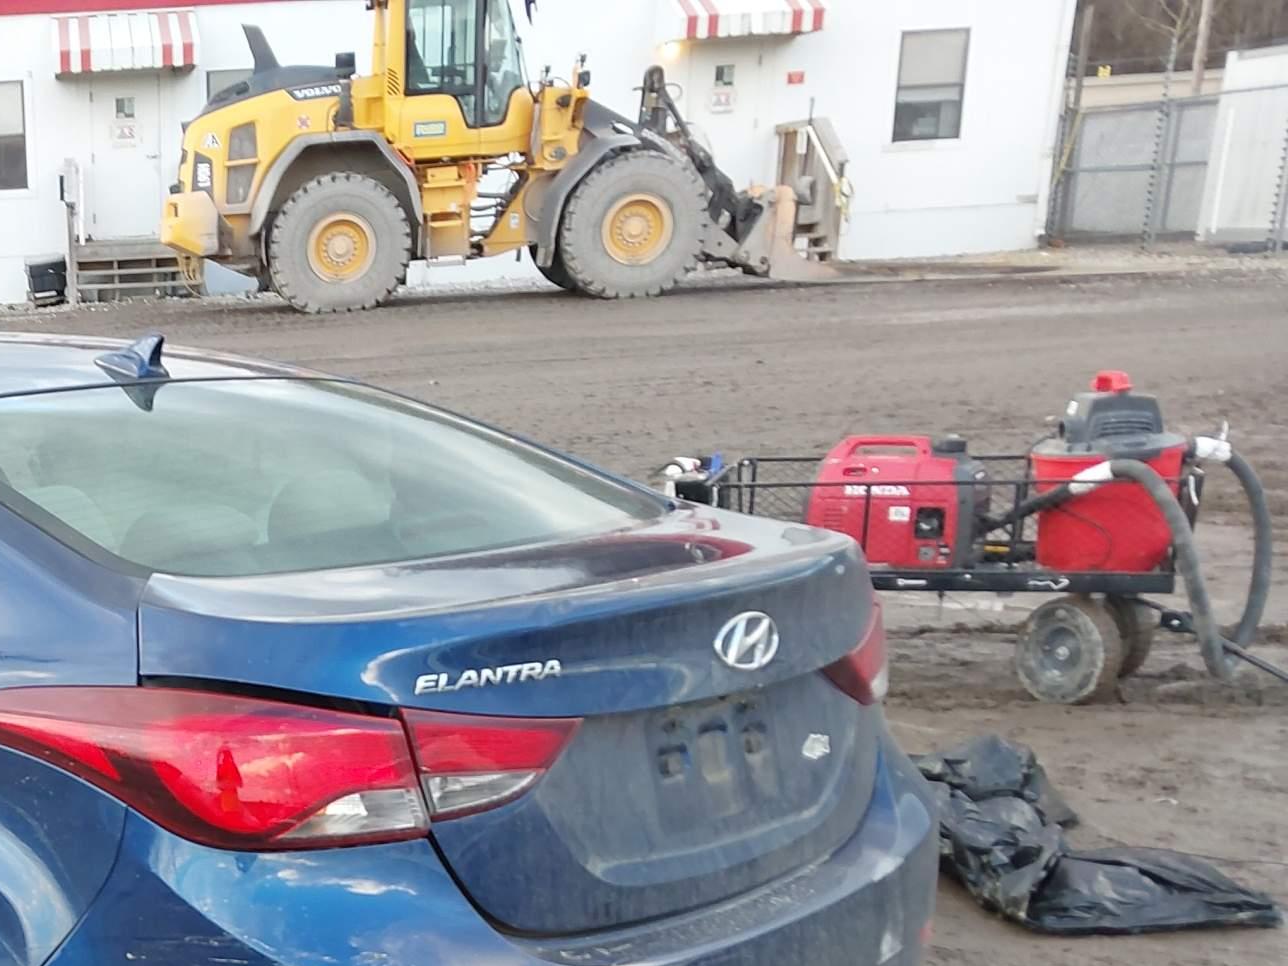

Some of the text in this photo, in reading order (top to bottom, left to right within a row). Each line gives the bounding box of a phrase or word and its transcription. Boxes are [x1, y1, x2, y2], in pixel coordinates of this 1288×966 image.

[292, 84, 342, 99] VOLVO
[843, 484, 911, 496] HONDA
[414, 659, 562, 695] ELANTRA
